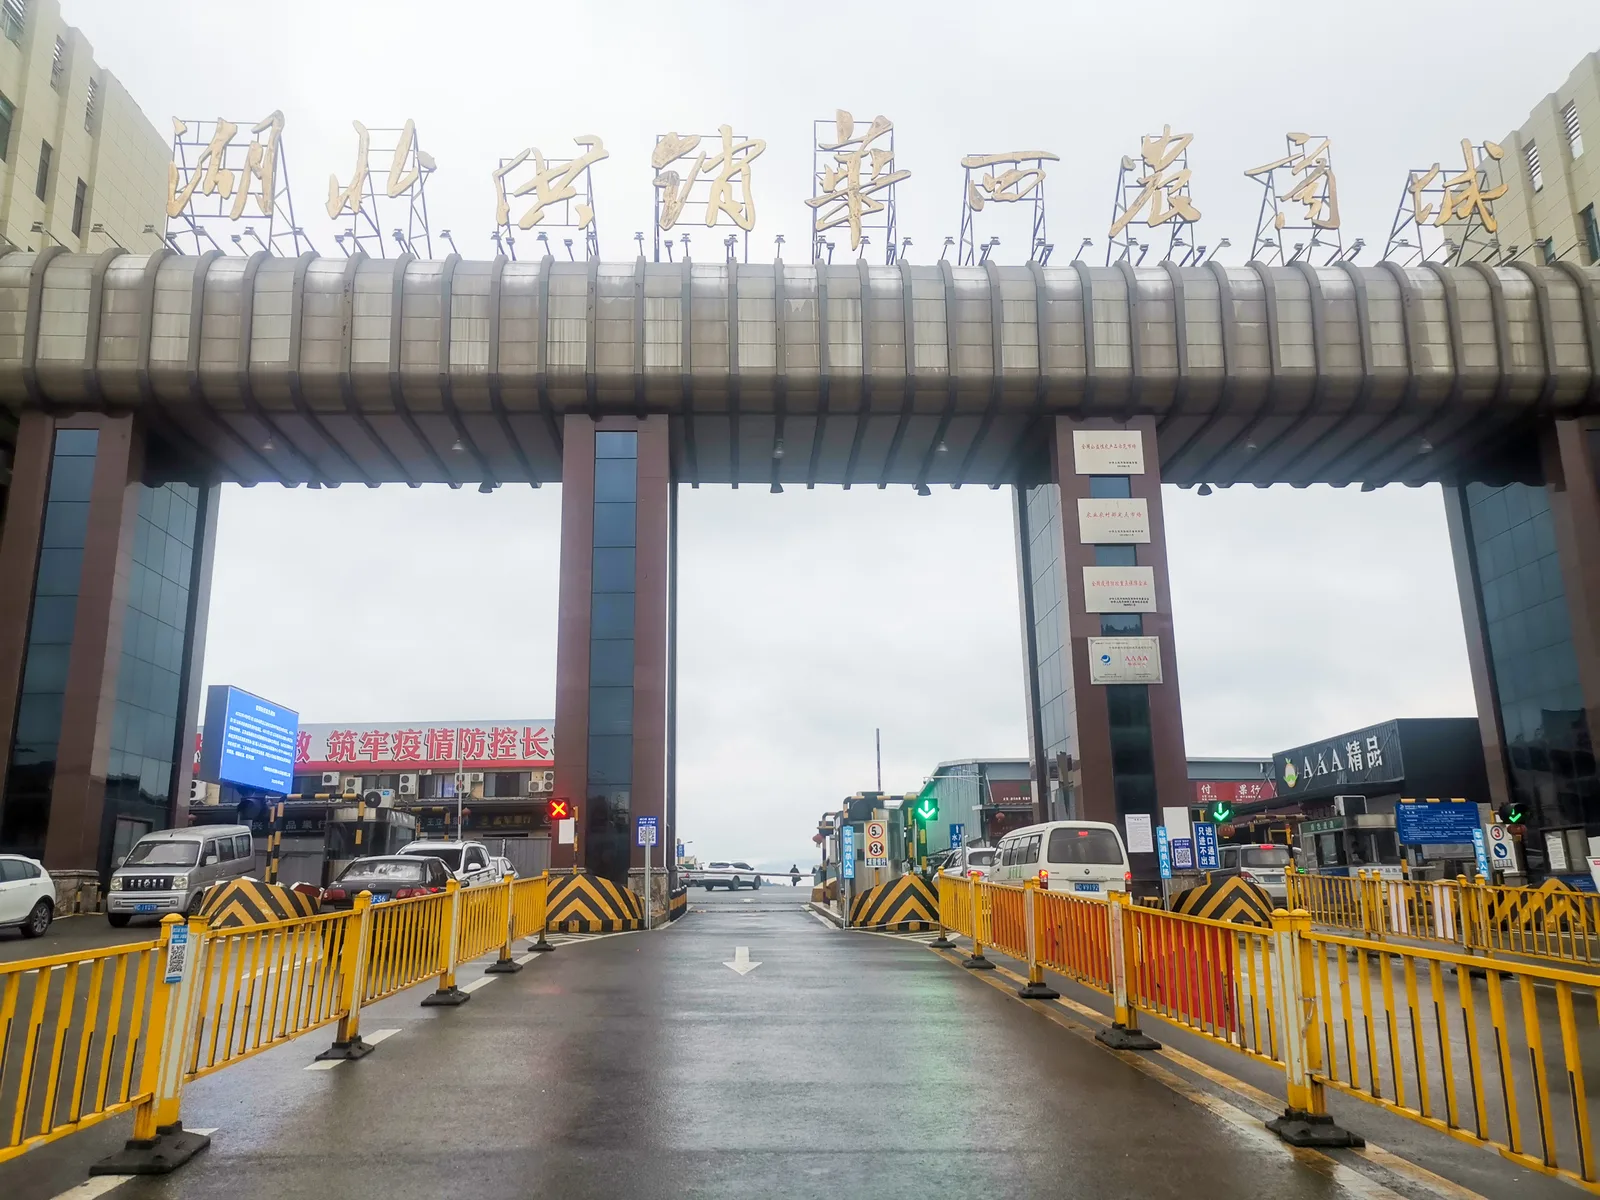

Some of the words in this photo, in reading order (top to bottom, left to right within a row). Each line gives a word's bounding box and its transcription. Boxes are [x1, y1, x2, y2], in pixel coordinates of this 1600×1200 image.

[326, 727, 553, 764] 筑牢疫情防控长
[1197, 826, 1208, 866] 只进不出
[1205, 826, 1216, 866] 进口通道
[1493, 828, 1501, 839] 3
